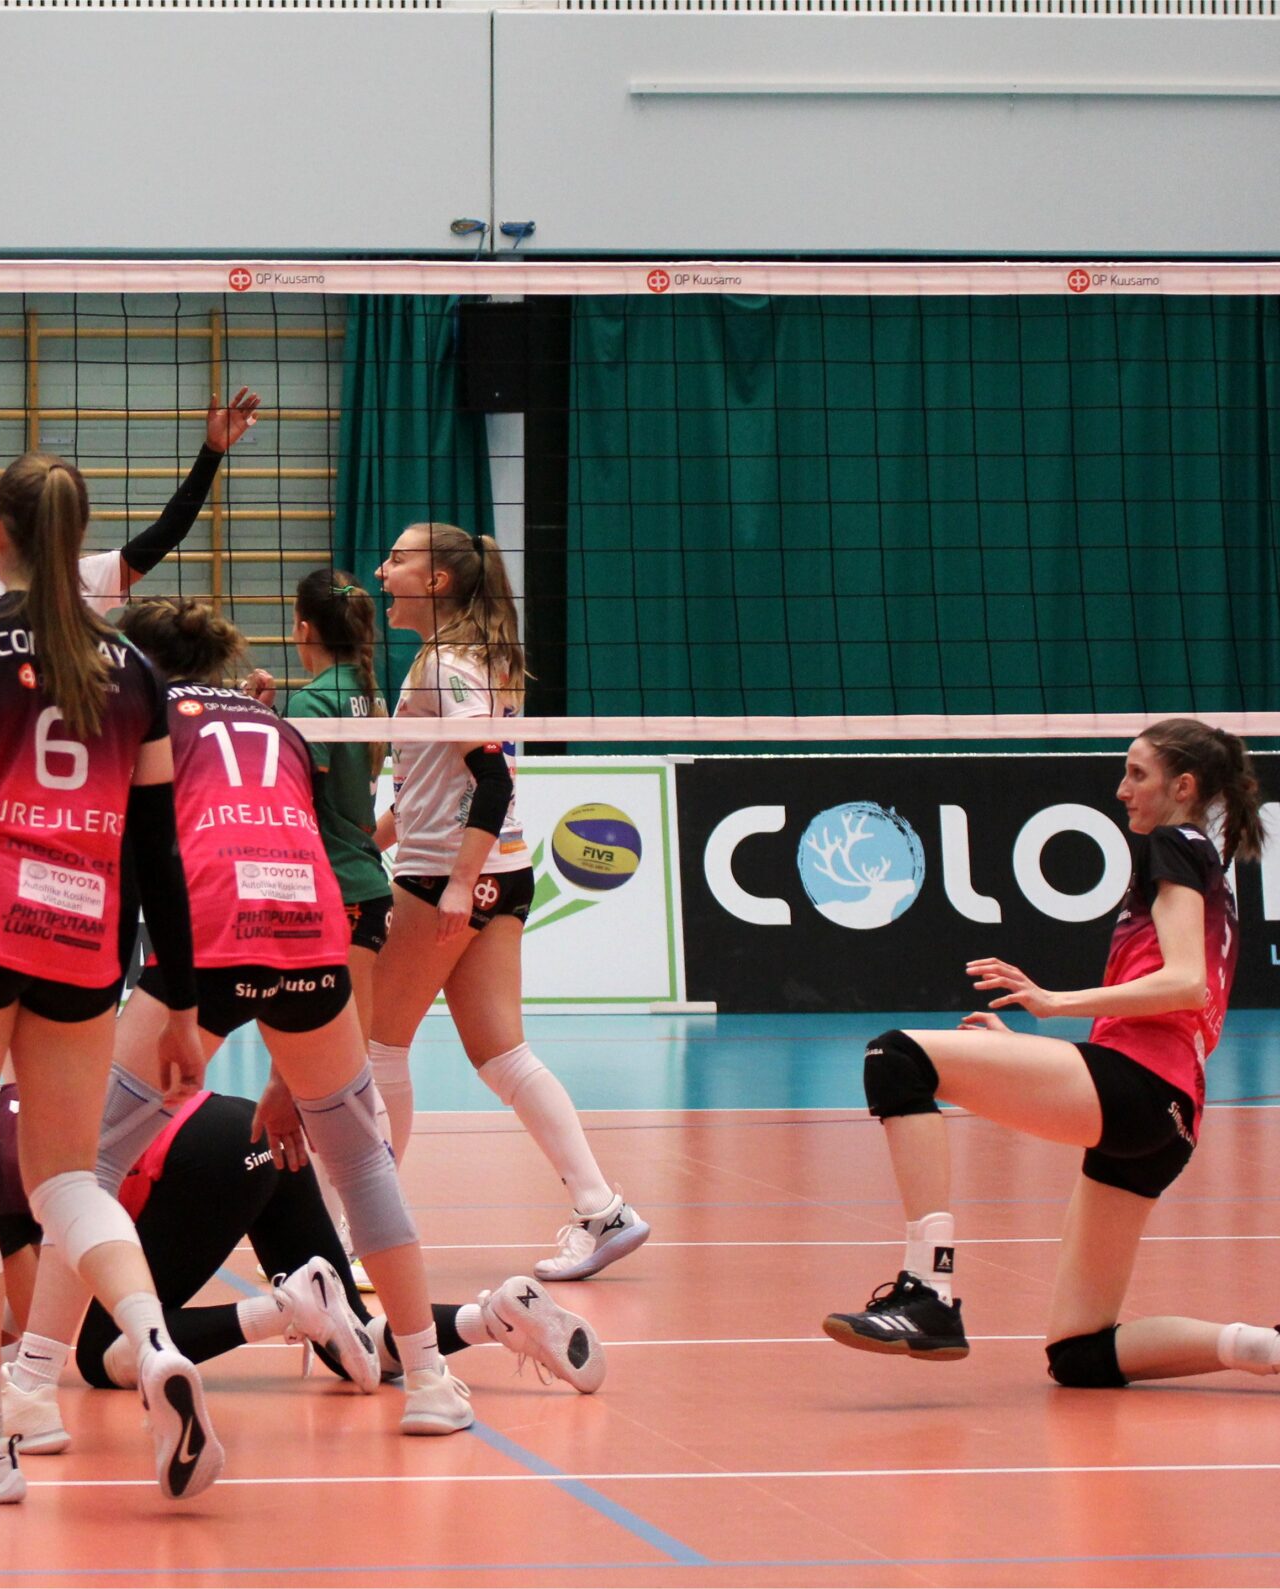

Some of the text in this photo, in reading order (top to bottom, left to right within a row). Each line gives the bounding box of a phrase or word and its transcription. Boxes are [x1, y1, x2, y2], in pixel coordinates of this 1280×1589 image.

[255, 273, 325, 284] OP Kuusamo
[674, 274, 742, 285] OP Kuusamo
[1092, 274, 1160, 286] OP Kuusamo
[35, 705, 89, 790] 6
[199, 720, 280, 787] 17
[583, 846, 615, 863] FIVB
[261, 866, 309, 879] TOYOTA
[50, 870, 102, 891] TOYOTA
